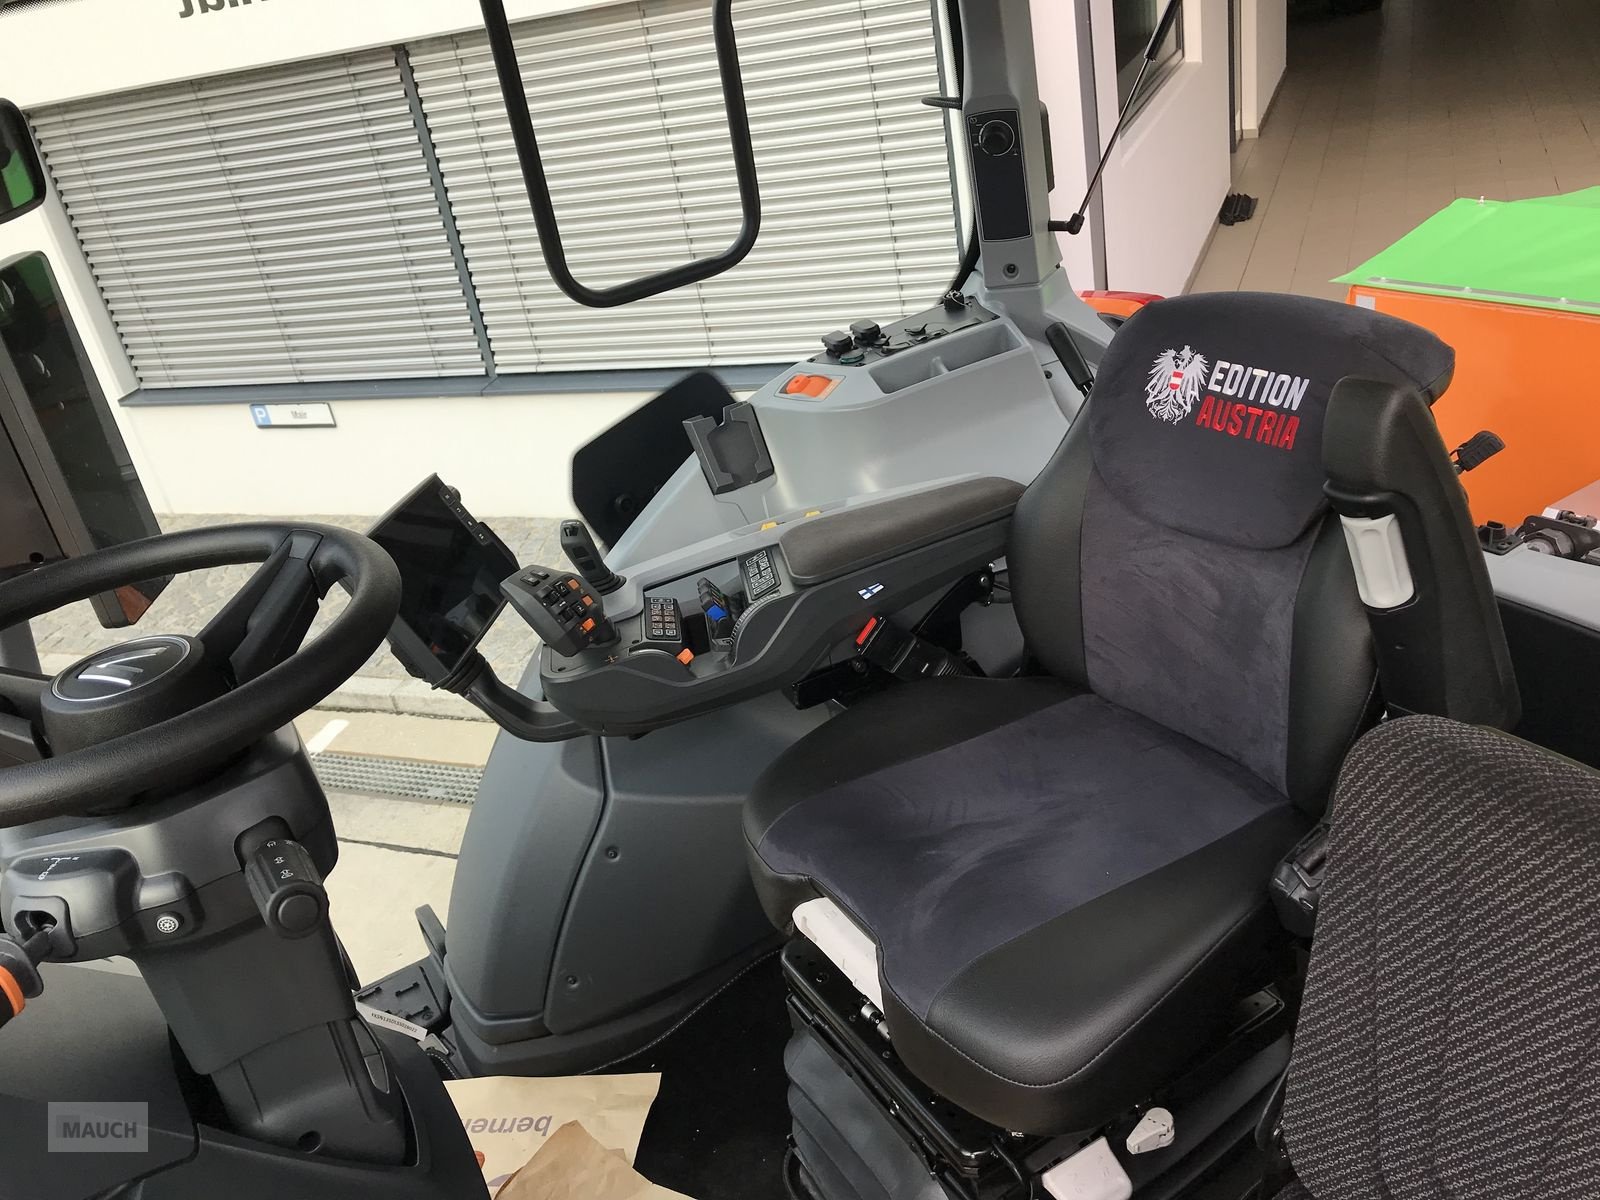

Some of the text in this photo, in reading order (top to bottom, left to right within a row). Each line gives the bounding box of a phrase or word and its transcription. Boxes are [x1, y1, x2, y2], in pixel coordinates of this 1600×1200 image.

[1207, 360, 1310, 411] EDITION
[254, 407, 267, 423] P
[1195, 395, 1300, 450] AUSTRIA
